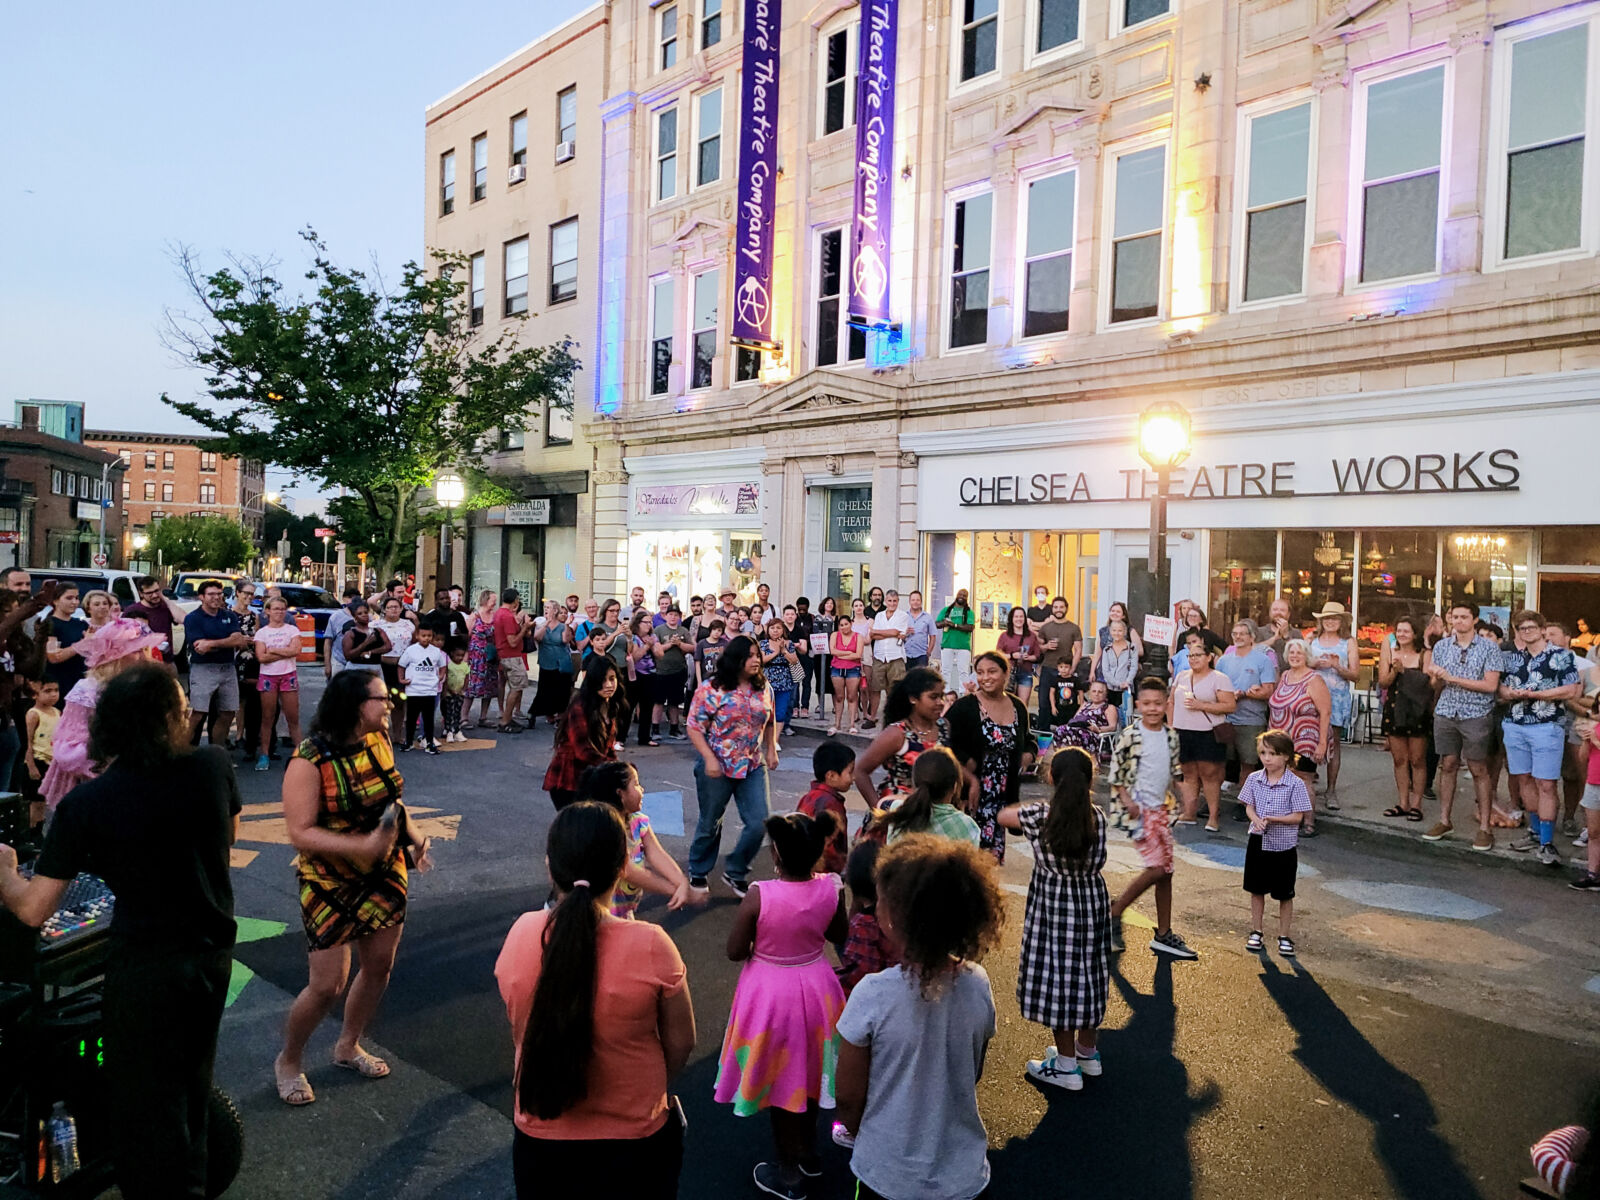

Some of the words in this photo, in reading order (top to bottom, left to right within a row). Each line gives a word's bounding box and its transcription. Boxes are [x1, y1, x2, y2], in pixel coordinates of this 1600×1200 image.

[868, 3, 890, 109] Theatre
[753, 58, 774, 155] Theatre
[741, 161, 769, 263] Company
[858, 117, 885, 231] Company
[1216, 387, 1264, 403] POST
[1279, 377, 1349, 398] OFFICE
[837, 500, 872, 511] CHELSE
[959, 472, 1091, 504] CHELSEA
[1119, 461, 1295, 499] THEATRE
[1332, 449, 1520, 493] WORKS
[836, 516, 872, 527] THEATR
